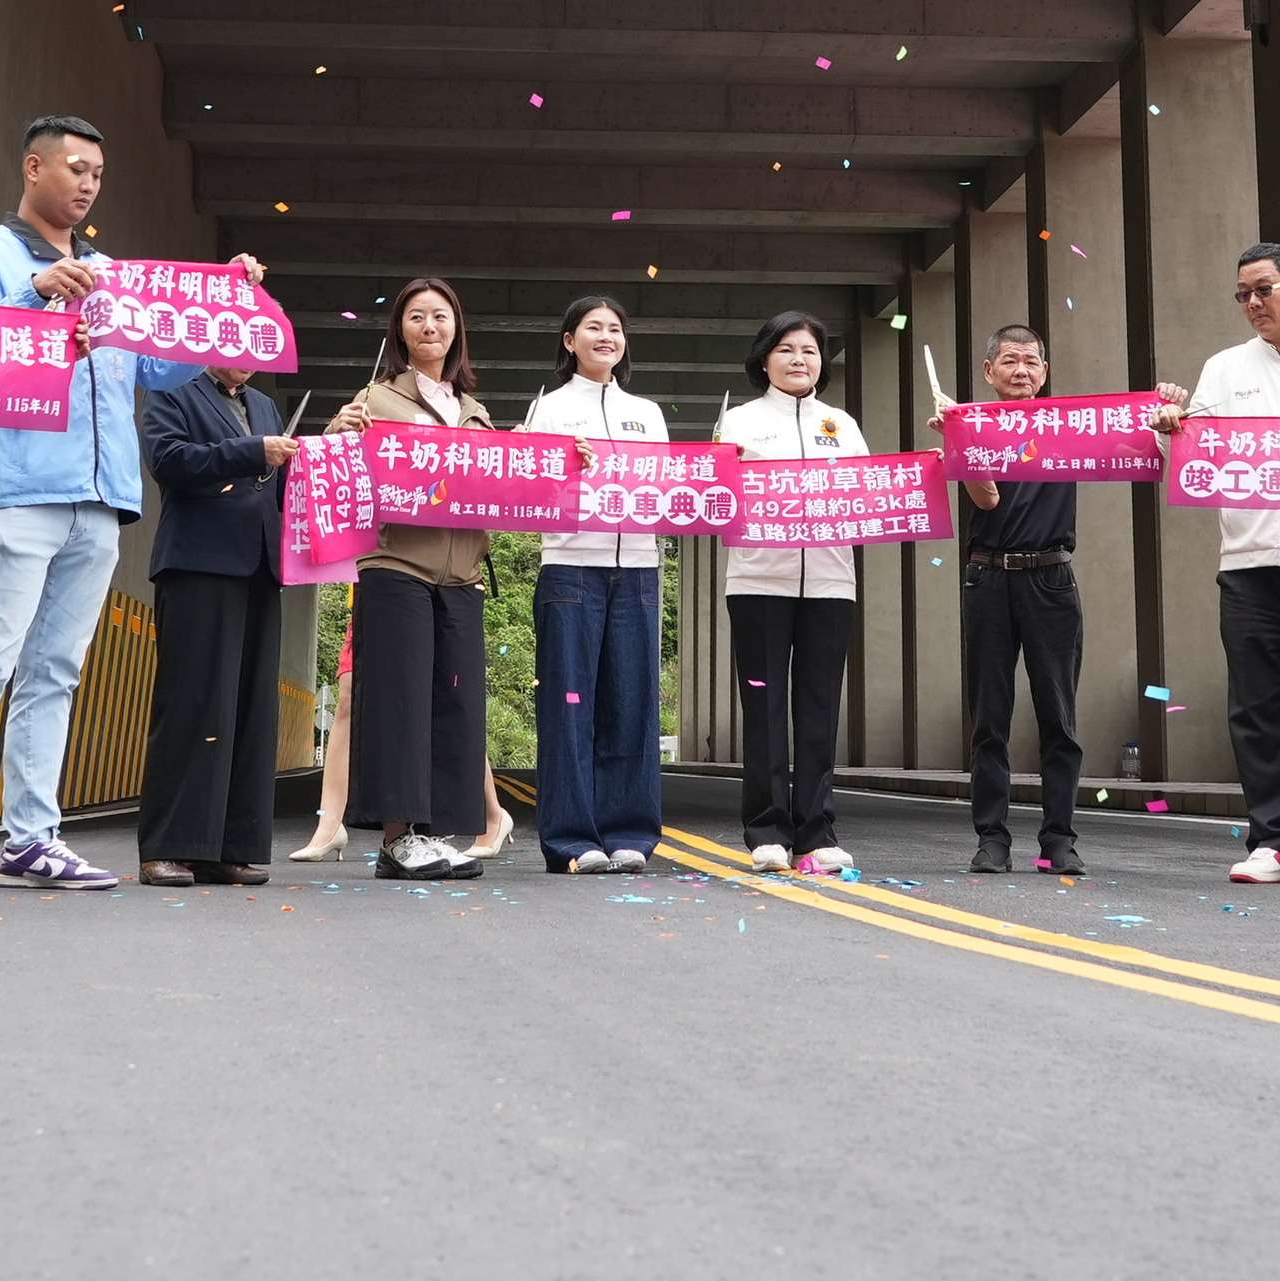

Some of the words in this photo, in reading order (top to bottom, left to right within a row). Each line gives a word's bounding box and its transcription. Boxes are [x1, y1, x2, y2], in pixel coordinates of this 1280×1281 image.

[84, 297, 279, 355] 竣工通車典禮
[377, 434, 568, 481] 牛奶科明隧道
[741, 461, 923, 495] 古坑鄉草嶺村
[741, 513, 931, 542] 道路災後復建工程
